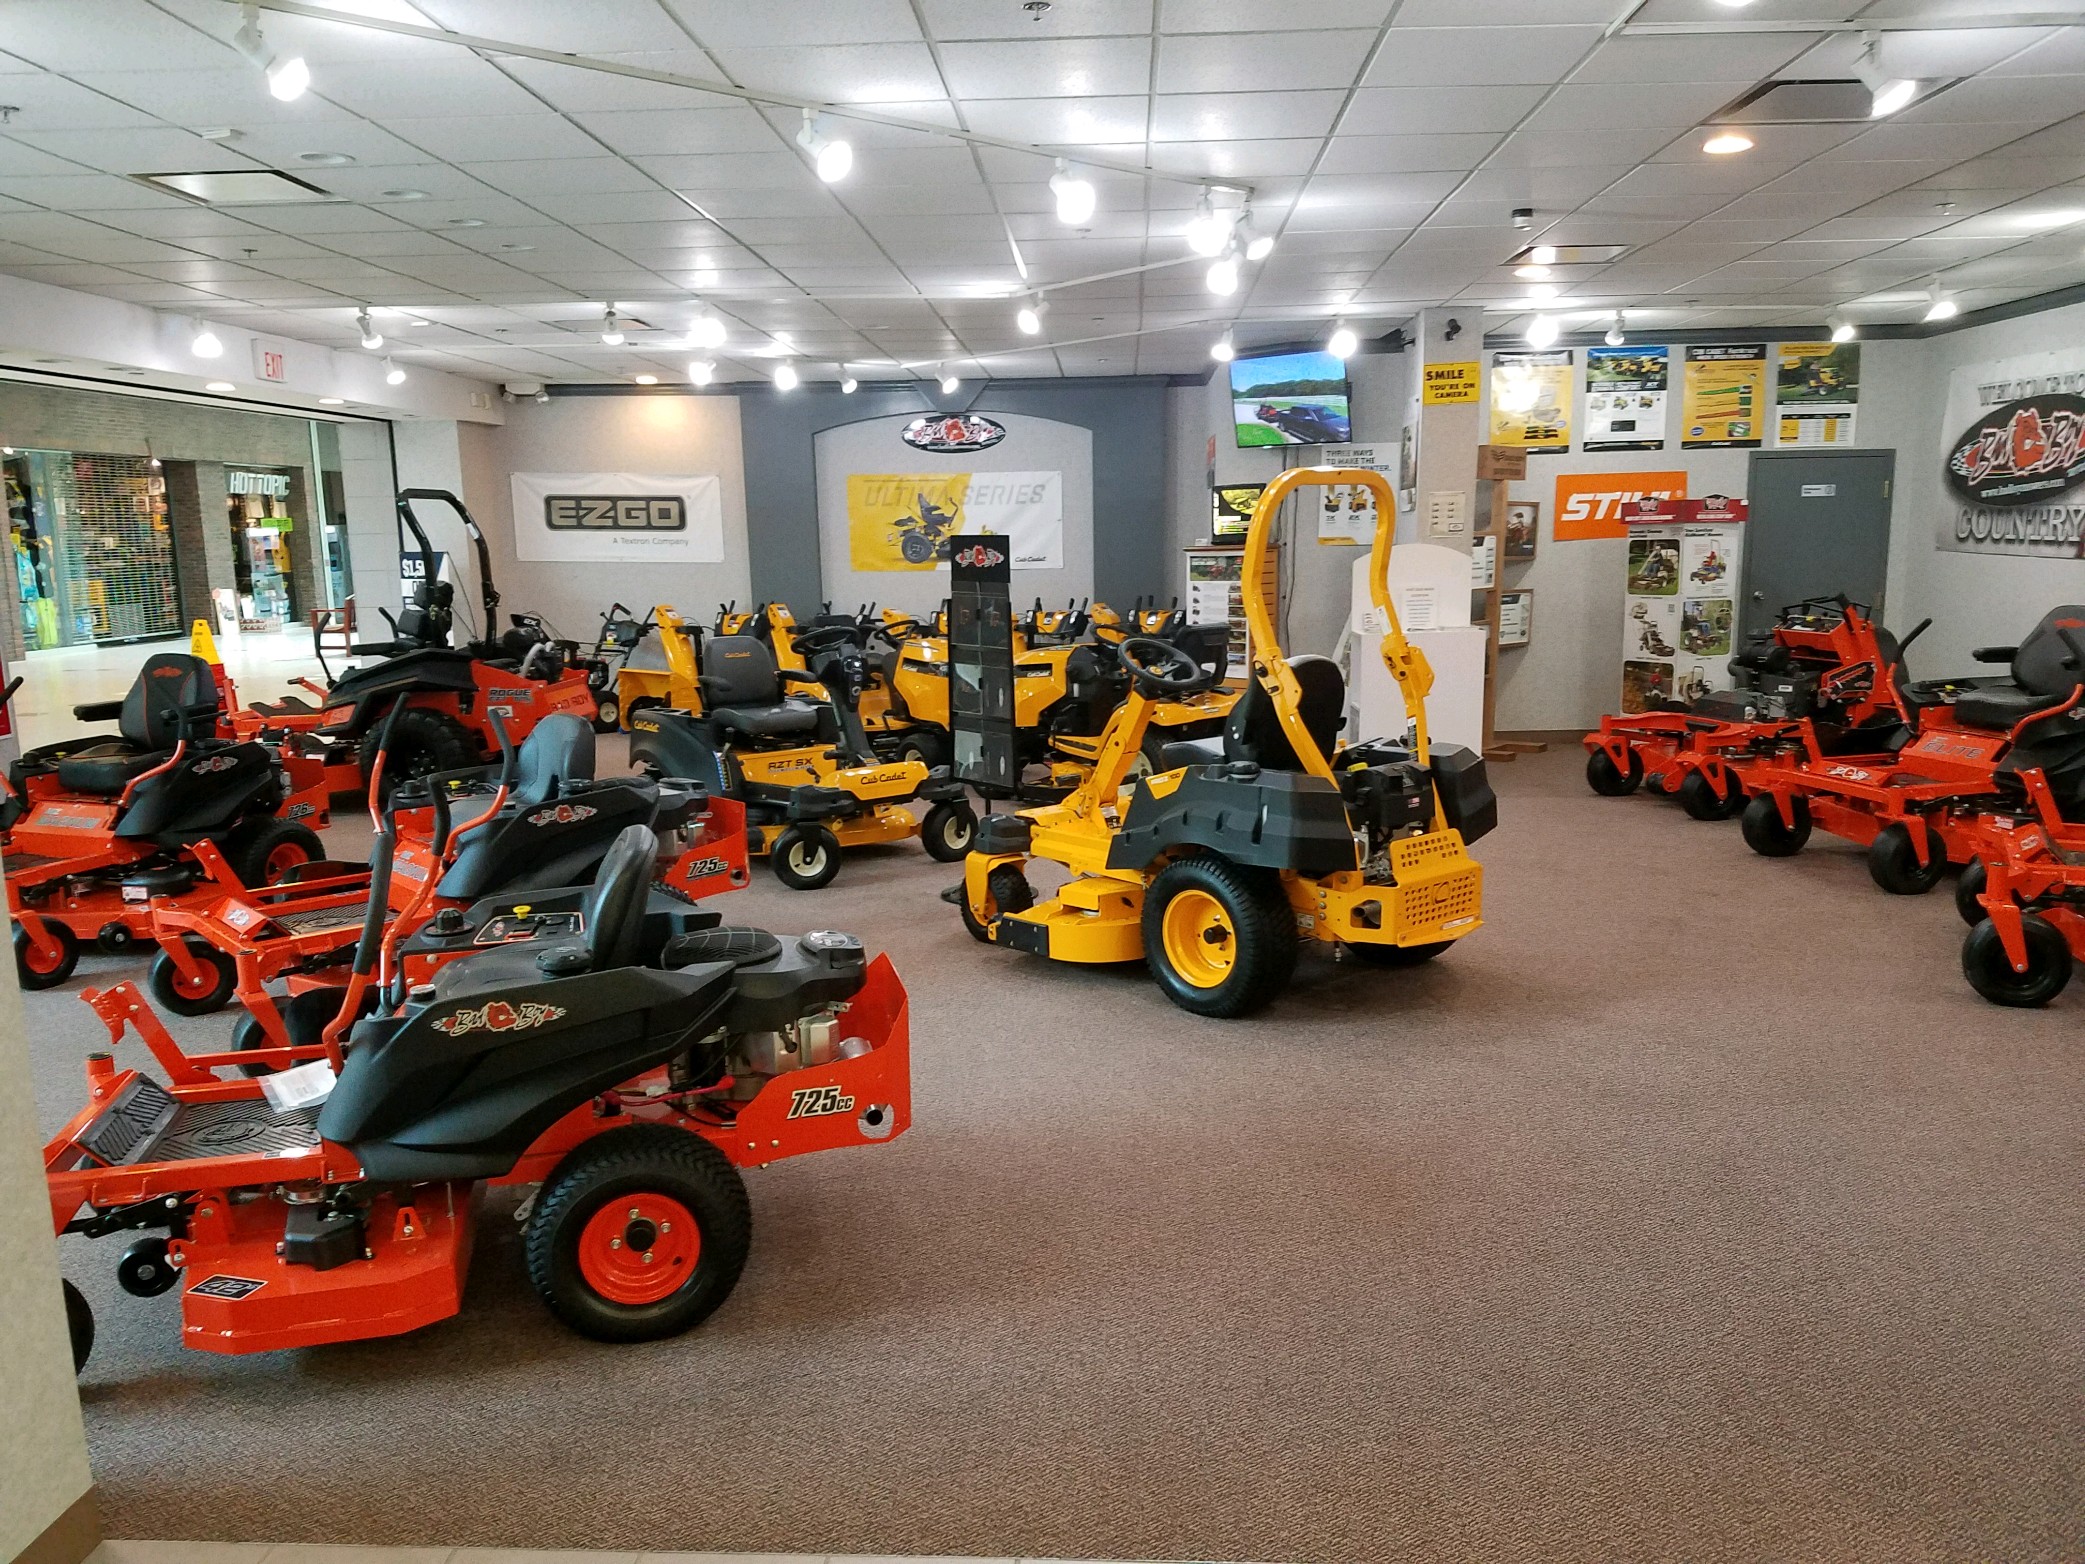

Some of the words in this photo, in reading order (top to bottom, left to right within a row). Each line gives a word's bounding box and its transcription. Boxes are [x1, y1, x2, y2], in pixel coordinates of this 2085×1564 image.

[265, 352, 284, 379] EXIT
[1426, 370, 1464, 380] SMILE
[230, 472, 256, 494] HOT
[257, 474, 290, 495] TOPIC
[863, 484, 950, 507] ULTIMA
[956, 484, 1046, 506] SERIES
[1561, 492, 1672, 521] STI
[550, 500, 681, 527] EZGO
[1956, 505, 2085, 542] COUNTRY
[652, 538, 689, 547] Company
[1922, 742, 1985, 758] ELITE
[768, 761, 792, 769] RZT
[795, 757, 813, 767] SX
[861, 776, 878, 785] Cub
[879, 771, 907, 782] Cadet
[688, 857, 728, 877] 725cc
[450, 1010, 494, 1036] Bad
[515, 1004, 550, 1031] Boy
[787, 1086, 855, 1119] 725cc
